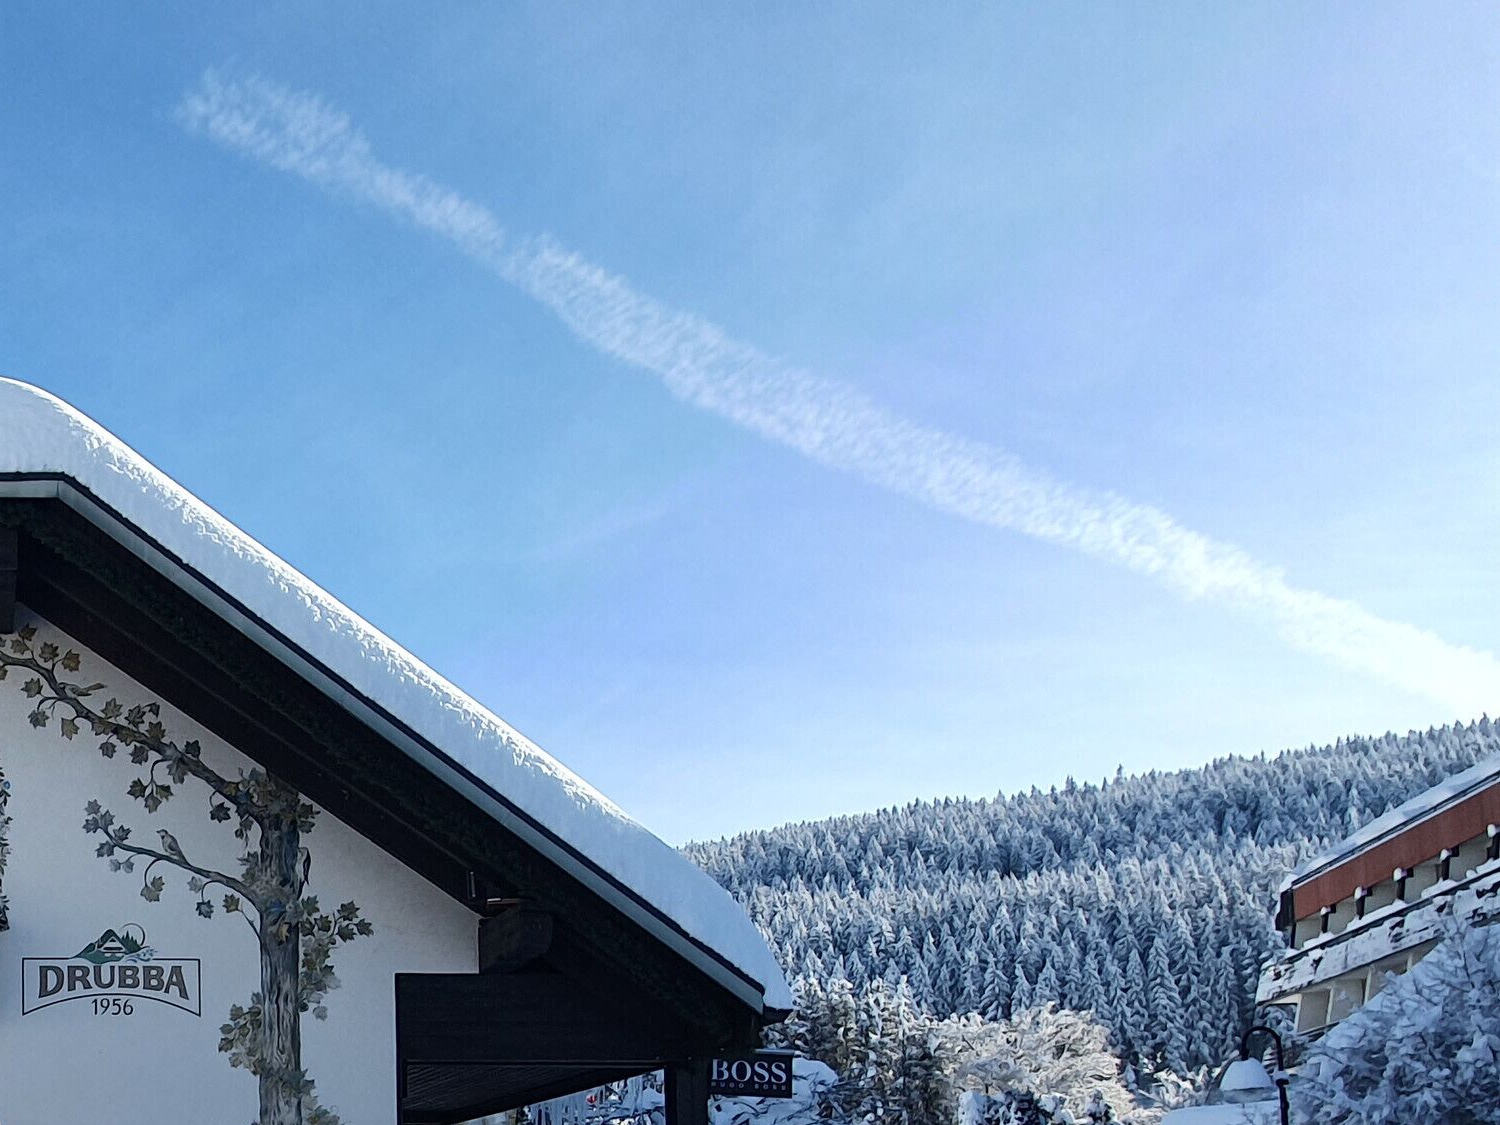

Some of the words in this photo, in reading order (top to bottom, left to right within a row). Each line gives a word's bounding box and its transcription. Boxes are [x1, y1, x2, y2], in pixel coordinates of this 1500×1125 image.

[38, 965, 190, 1001] DRUBBA
[91, 998, 134, 1016] 1956
[711, 1059, 787, 1084] BOSS
